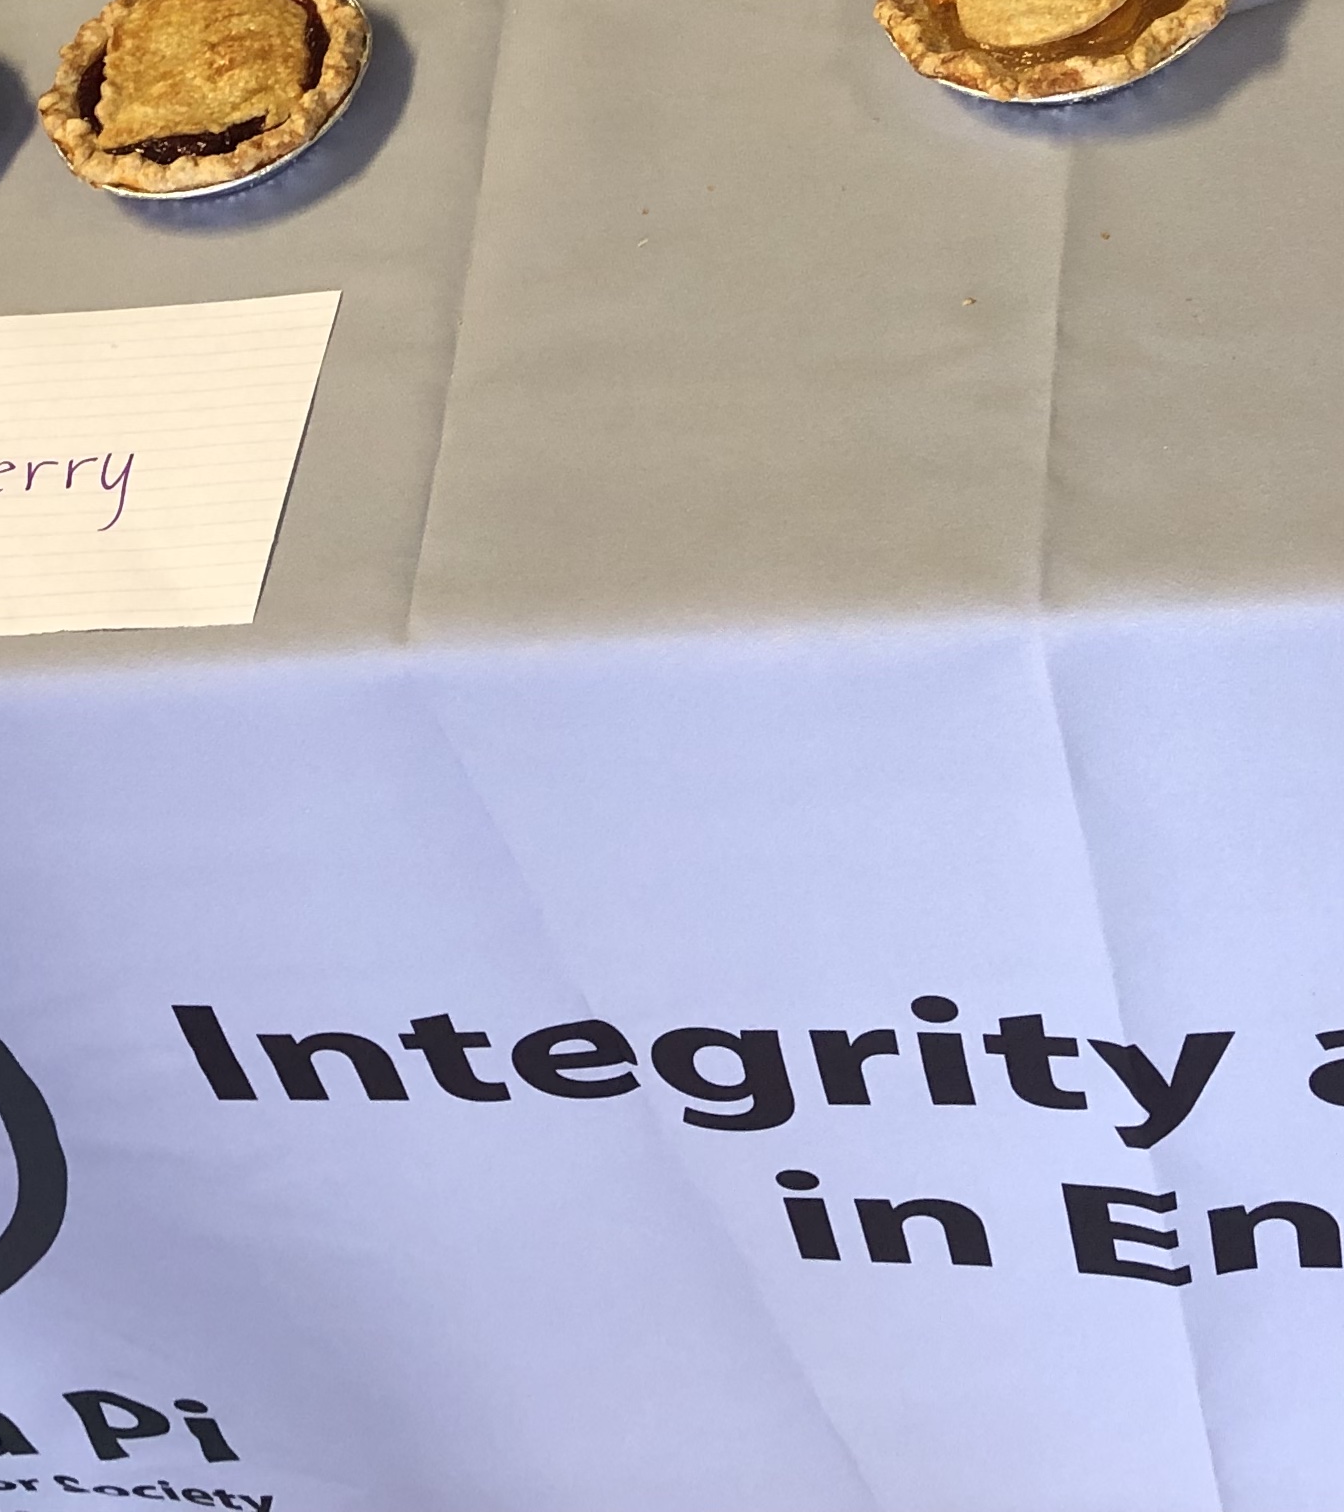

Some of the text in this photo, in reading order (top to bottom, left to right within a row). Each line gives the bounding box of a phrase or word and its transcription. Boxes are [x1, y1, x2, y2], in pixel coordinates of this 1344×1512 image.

[171, 995, 1236, 1150] Integrity
[775, 1169, 993, 1267] in
[62, 1389, 240, 1464] Pi
[52, 1474, 274, 1512] Society
